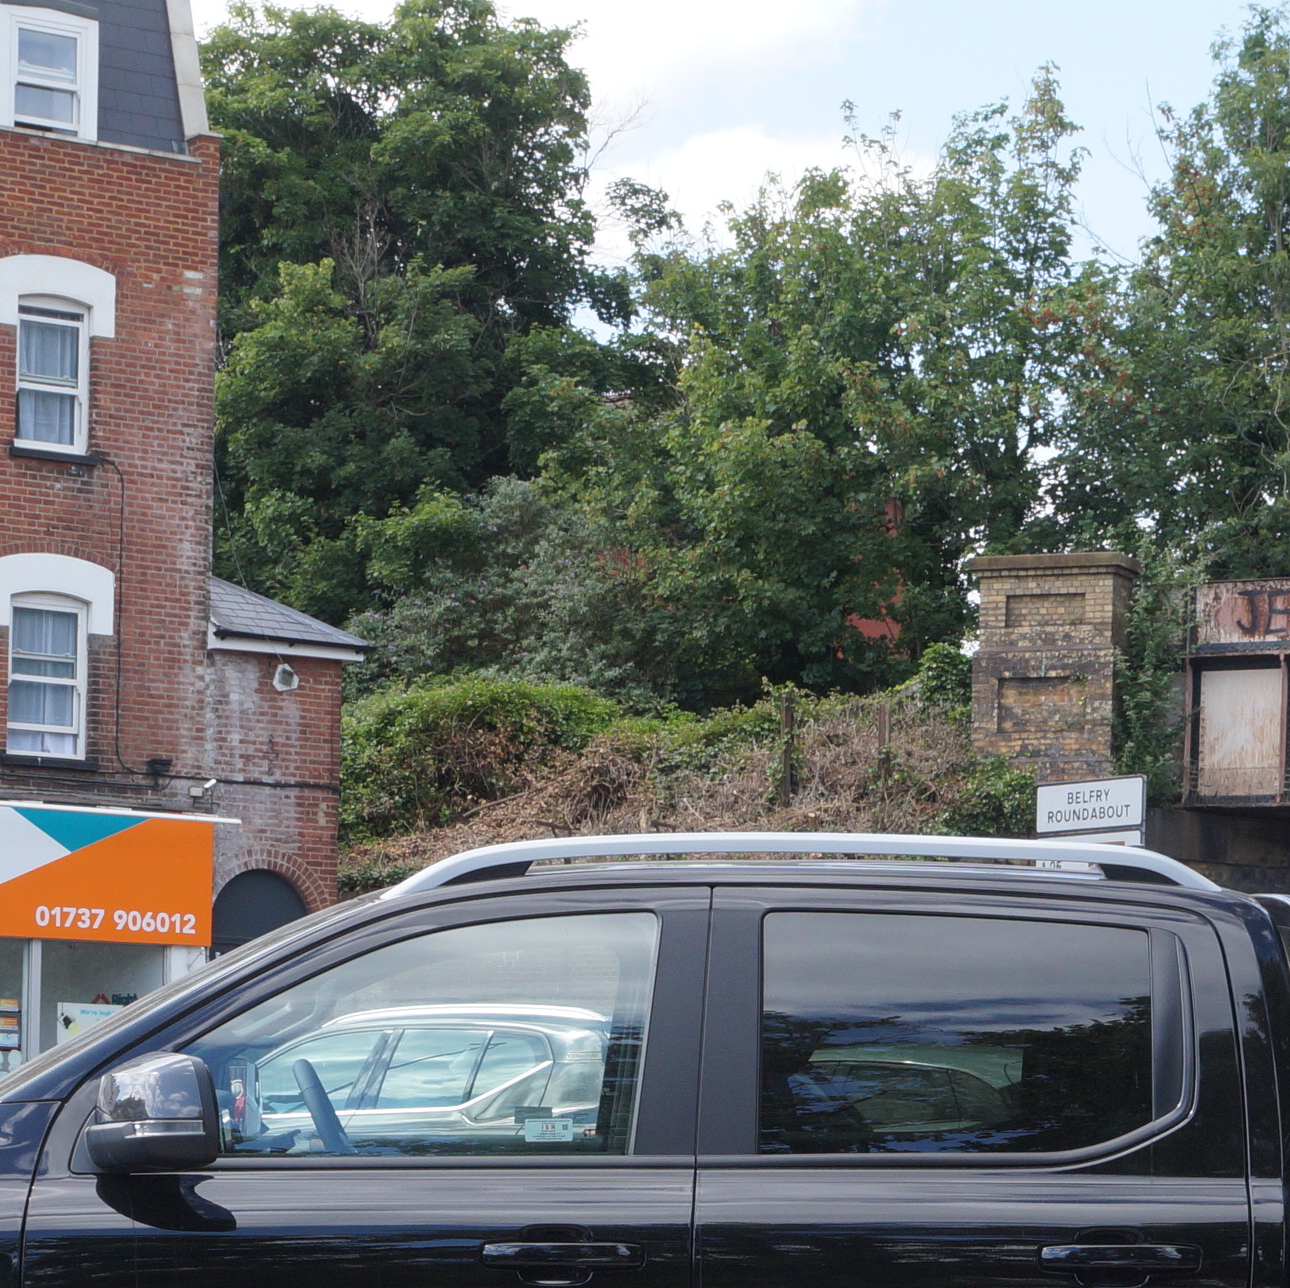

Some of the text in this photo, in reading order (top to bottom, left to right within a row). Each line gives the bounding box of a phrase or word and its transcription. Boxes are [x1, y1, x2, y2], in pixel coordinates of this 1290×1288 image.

[1067, 788, 1110, 805] BELFRY
[1047, 804, 1131, 824] ROUNDABOUT
[35, 905, 196, 935] 01737 906012
